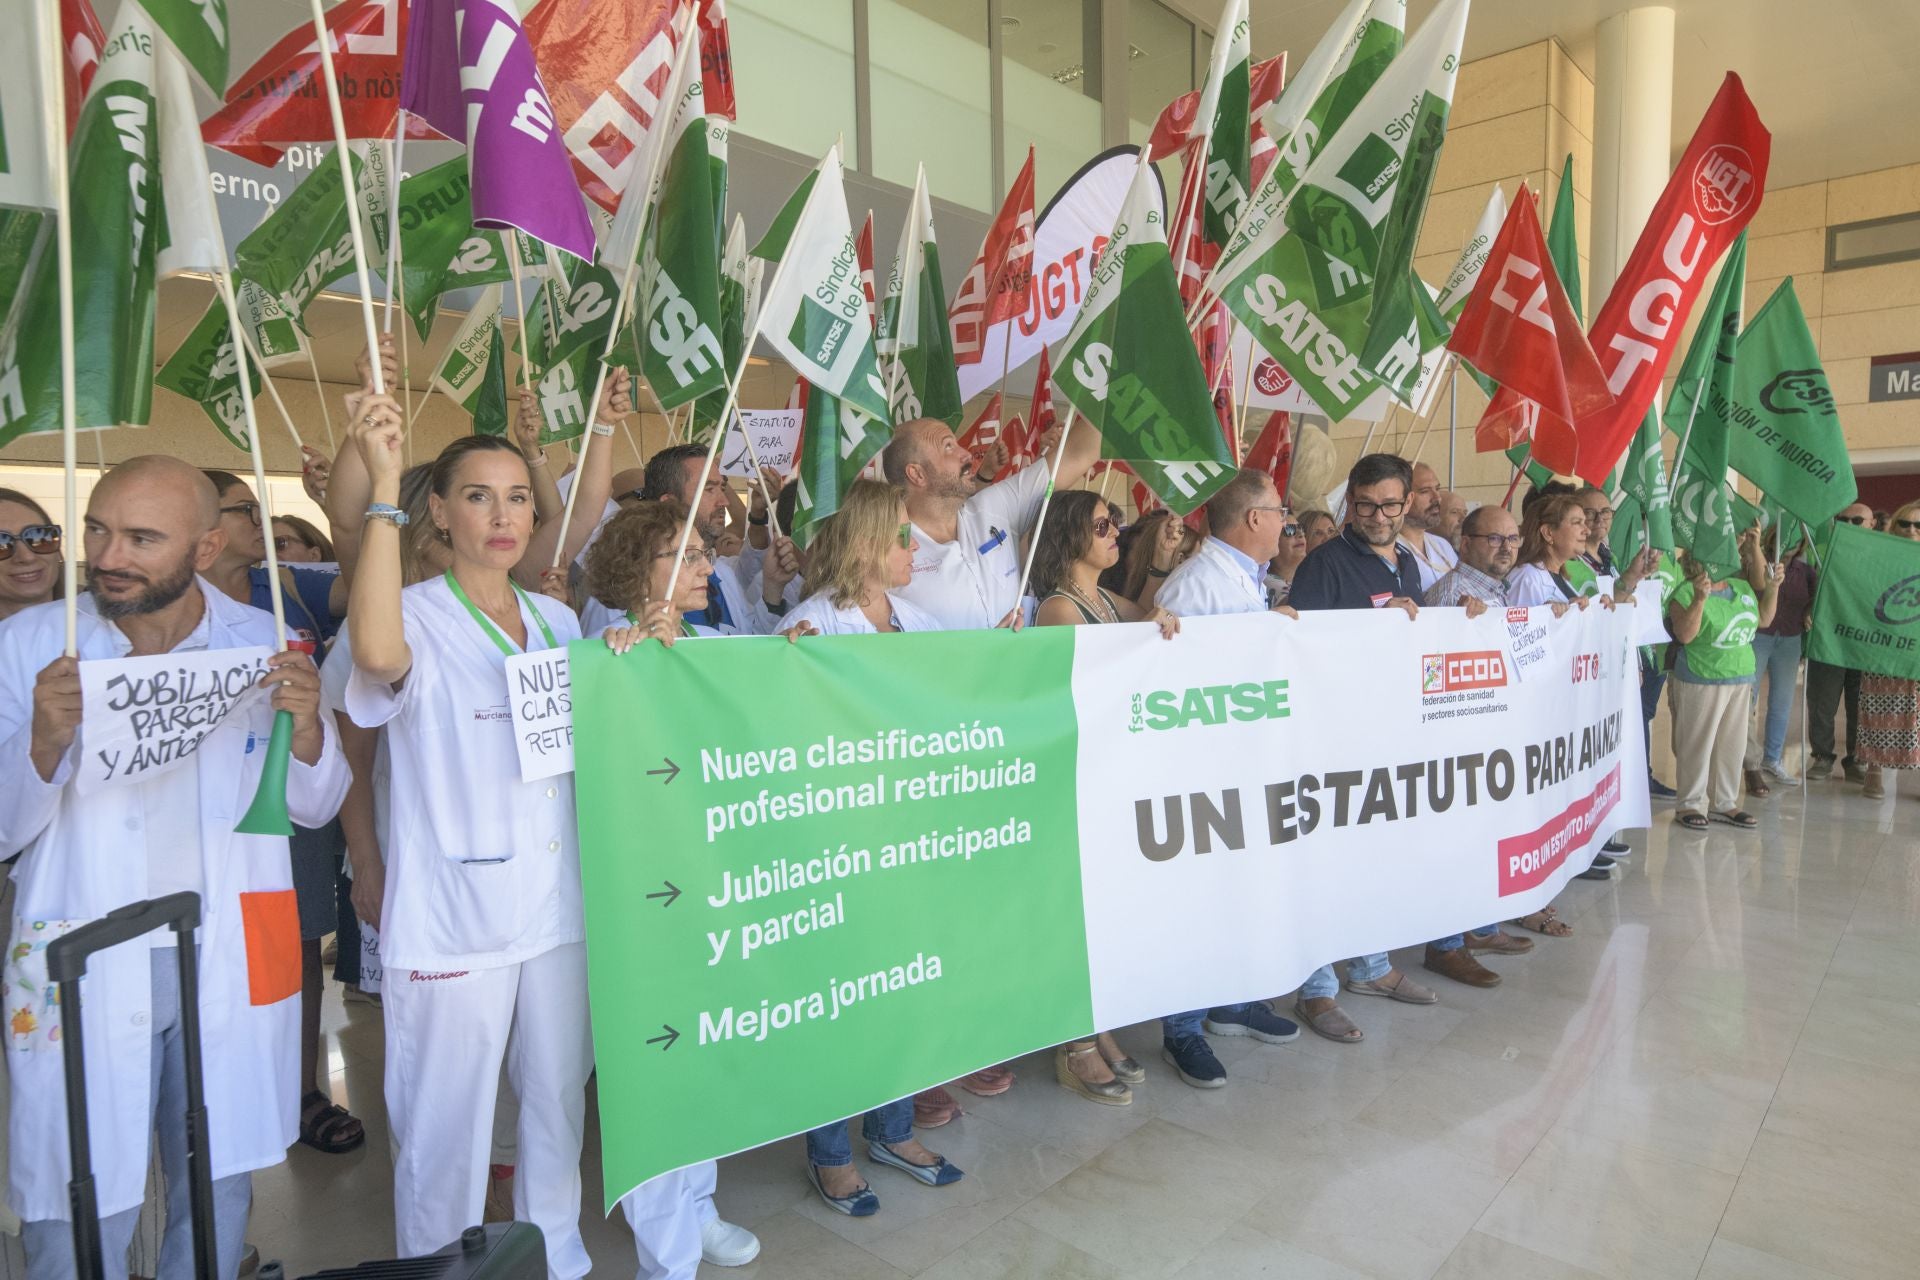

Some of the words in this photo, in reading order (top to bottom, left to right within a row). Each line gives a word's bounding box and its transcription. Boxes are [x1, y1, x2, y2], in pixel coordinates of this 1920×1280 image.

[1704, 151, 1751, 200] UGT
[1608, 212, 1707, 396] UGT
[816, 319, 846, 365] SATSE
[1243, 273, 1377, 405] SATSE
[451, 362, 474, 386] SATSE
[1755, 425, 1782, 446] DE
[1776, 439, 1836, 484] MURCIA
[1834, 623, 1893, 647] REGIÓN
[1896, 636, 1917, 652] DE
[106, 657, 276, 711] JUBILACIÓ
[518, 658, 574, 695] NUE
[1448, 657, 1503, 684] CCOO
[1571, 654, 1591, 685] UGT
[130, 697, 238, 740] PARCIA
[1128, 692, 1145, 734] fses
[1144, 679, 1291, 731] SATSE
[1422, 692, 1457, 706] federación
[1457, 692, 1466, 702] de
[1466, 689, 1495, 701] sanidad
[1427, 710, 1455, 721] sectores
[1456, 702, 1508, 717] sociosanitarios
[98, 749, 120, 781] Y
[700, 745, 797, 783] Nueva
[806, 720, 1005, 769] clasificación
[706, 774, 885, 842] profesional
[894, 757, 1037, 802] retribuida
[1134, 787, 1246, 862] UN
[1264, 748, 1515, 846] ESTATUTO
[1525, 732, 1574, 795] PARA
[707, 843, 872, 909] Jubilación
[880, 817, 1032, 869] anticipada
[1509, 848, 1541, 878] POR
[1540, 840, 1551, 866] UN
[707, 929, 731, 967] y
[741, 892, 845, 960] parcial
[699, 991, 824, 1045] Mejora
[829, 952, 943, 1020] jornada
